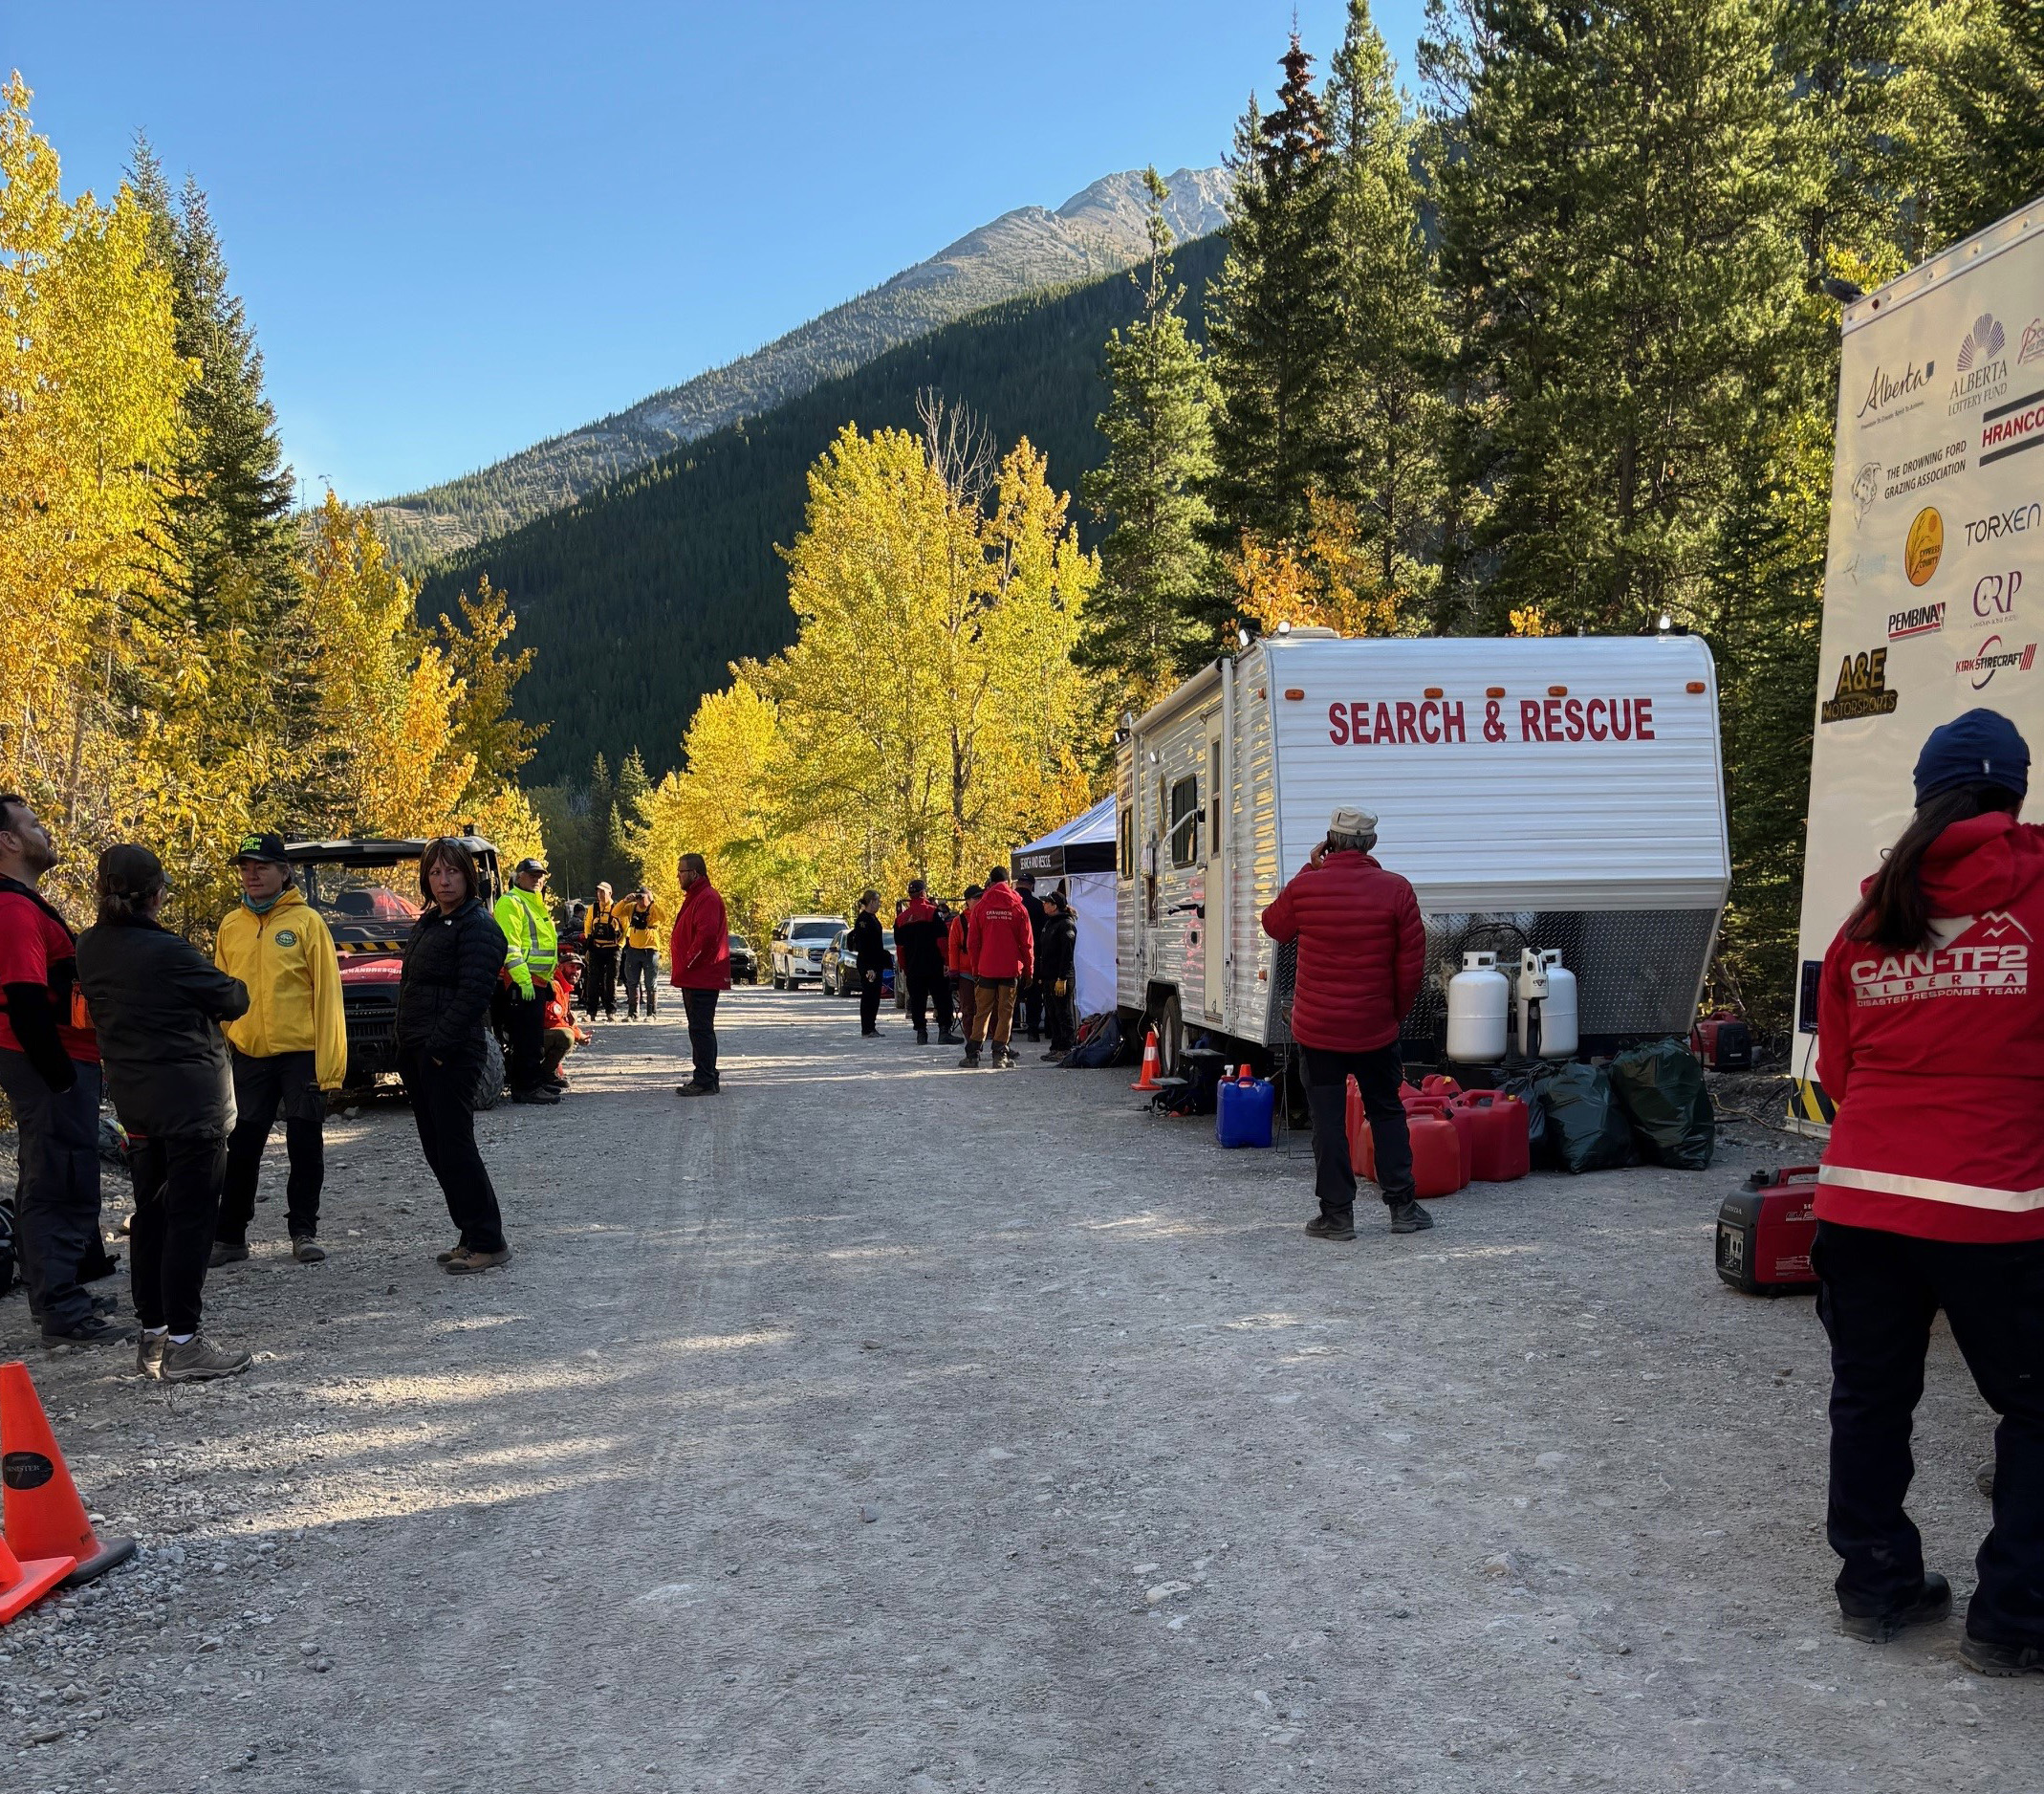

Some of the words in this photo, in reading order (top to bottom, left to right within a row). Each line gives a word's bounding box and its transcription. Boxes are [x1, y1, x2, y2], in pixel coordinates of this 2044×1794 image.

[1857, 361, 1932, 418] Alberta
[1948, 393, 1982, 416] LOTTERY
[1984, 383, 2008, 401] FUND
[1949, 360, 2008, 400] ALBERTA
[1884, 477, 1916, 500] GRAZING
[1916, 459, 1967, 488] ASSOCIATION
[1886, 466, 1900, 481] THE
[1903, 448, 1943, 475] DROWNING
[1946, 440, 1967, 459] FORD
[1973, 571, 2022, 617] CRP
[1888, 603, 1940, 633] PEMBINA
[1837, 651, 1886, 695] A&E
[1328, 701, 1467, 745] SEARCH
[1483, 700, 1507, 742] &
[1520, 698, 1656, 742] RESCUE
[1822, 693, 1897, 719] MOTORSPORTS
[1850, 945, 2028, 984] CAN-TF2
[1861, 972, 2017, 997] ALBERTA
[1857, 995, 1908, 1007] DISASTER
[1912, 988, 1980, 1000] RESPONSE
[1986, 987, 2027, 995] TEAM
